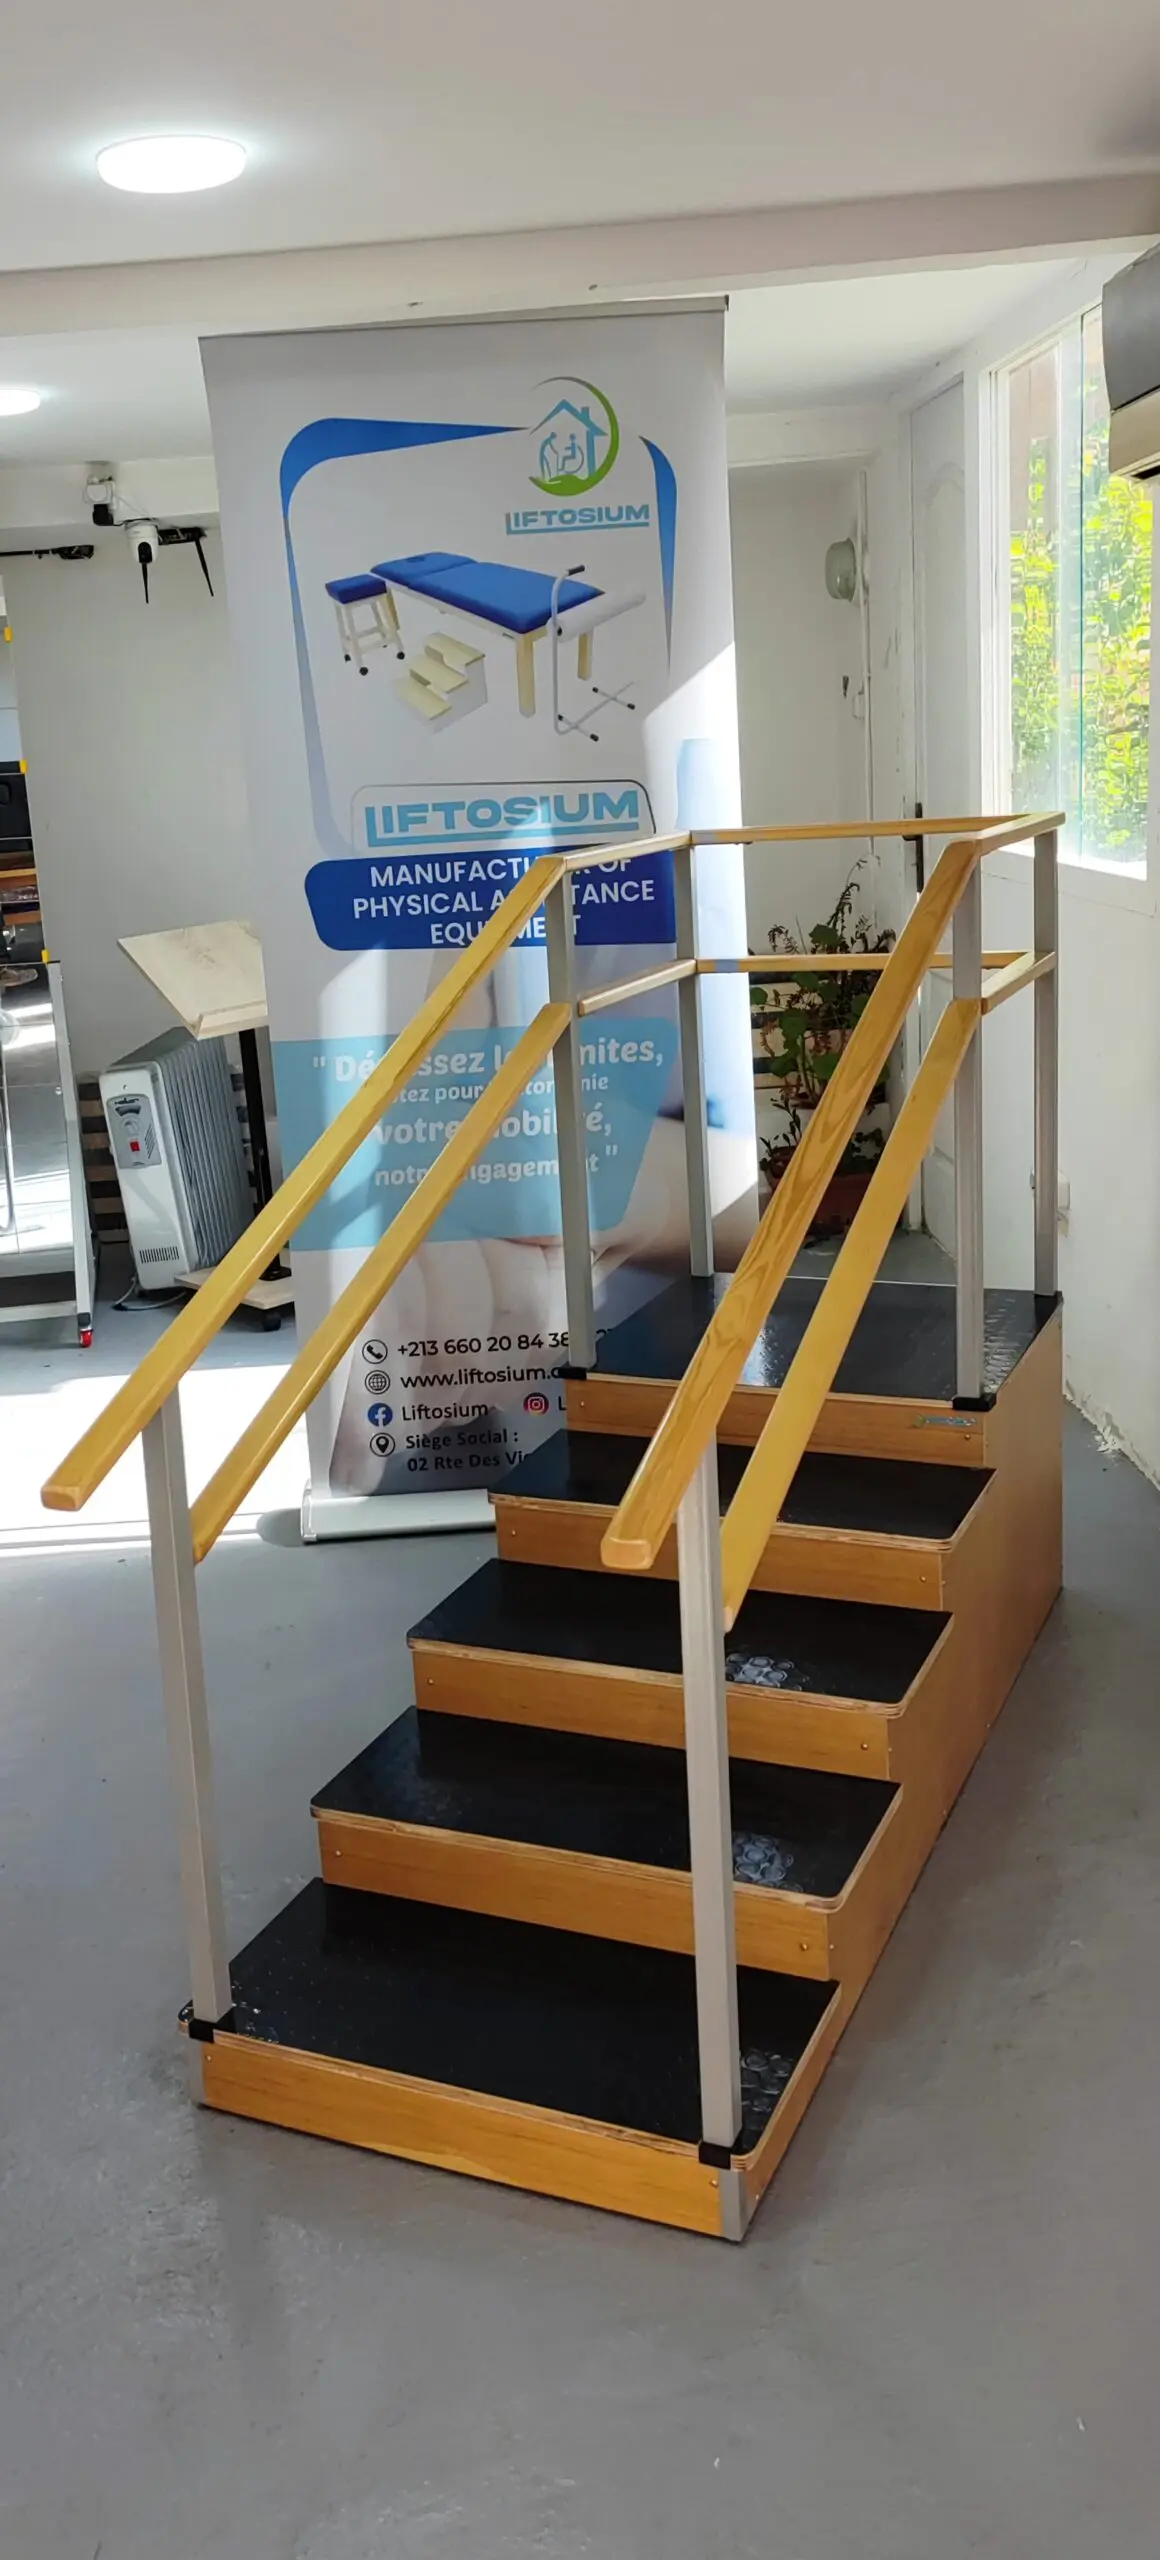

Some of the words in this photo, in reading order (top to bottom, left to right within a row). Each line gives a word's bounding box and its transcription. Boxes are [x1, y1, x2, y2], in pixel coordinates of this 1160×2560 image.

[505, 504, 650, 535] LIFTOSIUM
[365, 791, 640, 847] LIFTOSIUM
[353, 891, 484, 919] PHYSICAL
[435, 1084, 484, 1105] pour
[397, 1340, 439, 1359] +213
[443, 1338, 482, 1356] 660
[486, 1336, 512, 1353] 20
[517, 1333, 544, 1350] 84
[401, 1403, 489, 1422] Liftosium
[405, 1434, 452, 1451] Siège
[457, 1428, 508, 1446] Social
[407, 1457, 429, 1472] 02
[434, 1456, 463, 1470] Rte
[469, 1453, 500, 1468] Des
